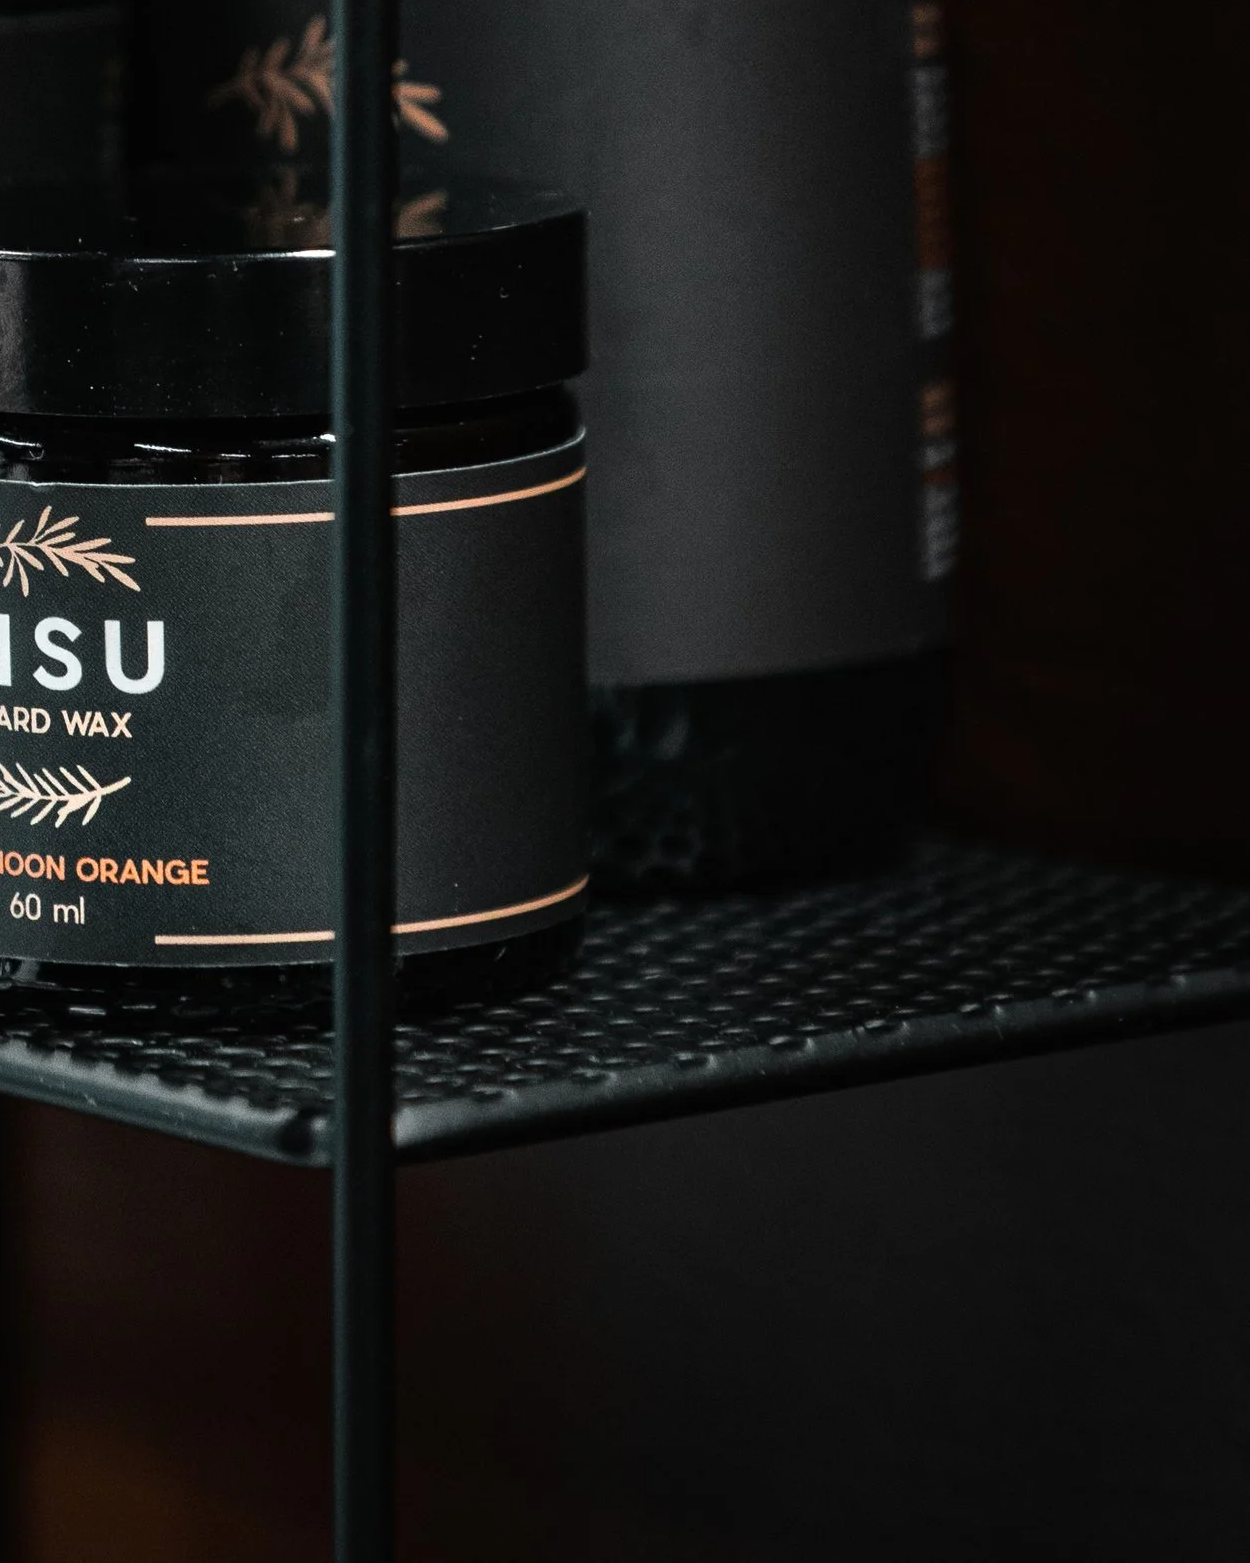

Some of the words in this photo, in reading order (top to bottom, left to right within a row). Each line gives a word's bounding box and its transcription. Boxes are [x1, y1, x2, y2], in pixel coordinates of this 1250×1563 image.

[60, 709, 133, 739] WAX
[75, 856, 211, 886] ORANGE
[9, 892, 42, 921] 60
[53, 896, 86, 925] ml
